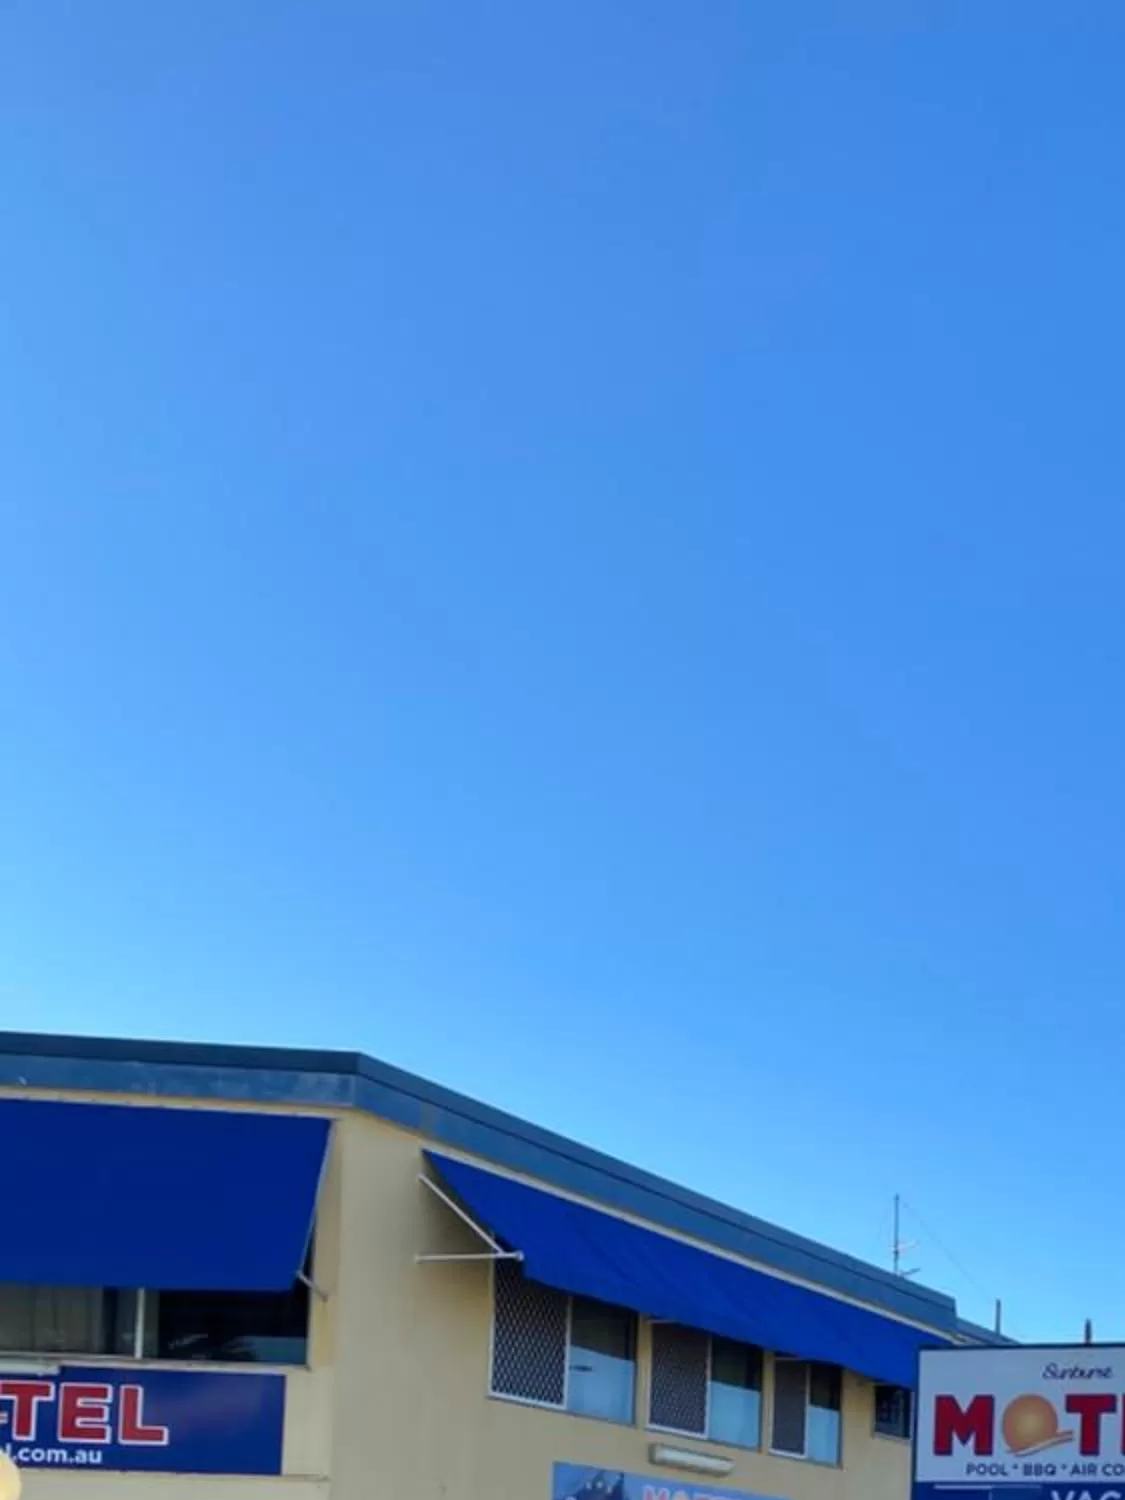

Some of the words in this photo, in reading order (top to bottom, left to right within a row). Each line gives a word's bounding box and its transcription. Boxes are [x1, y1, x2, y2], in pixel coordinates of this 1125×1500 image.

[966, 1463, 1008, 1477] POOL
[1023, 1463, 1057, 1478] BBQ
[1070, 1463, 1098, 1477] AIR
